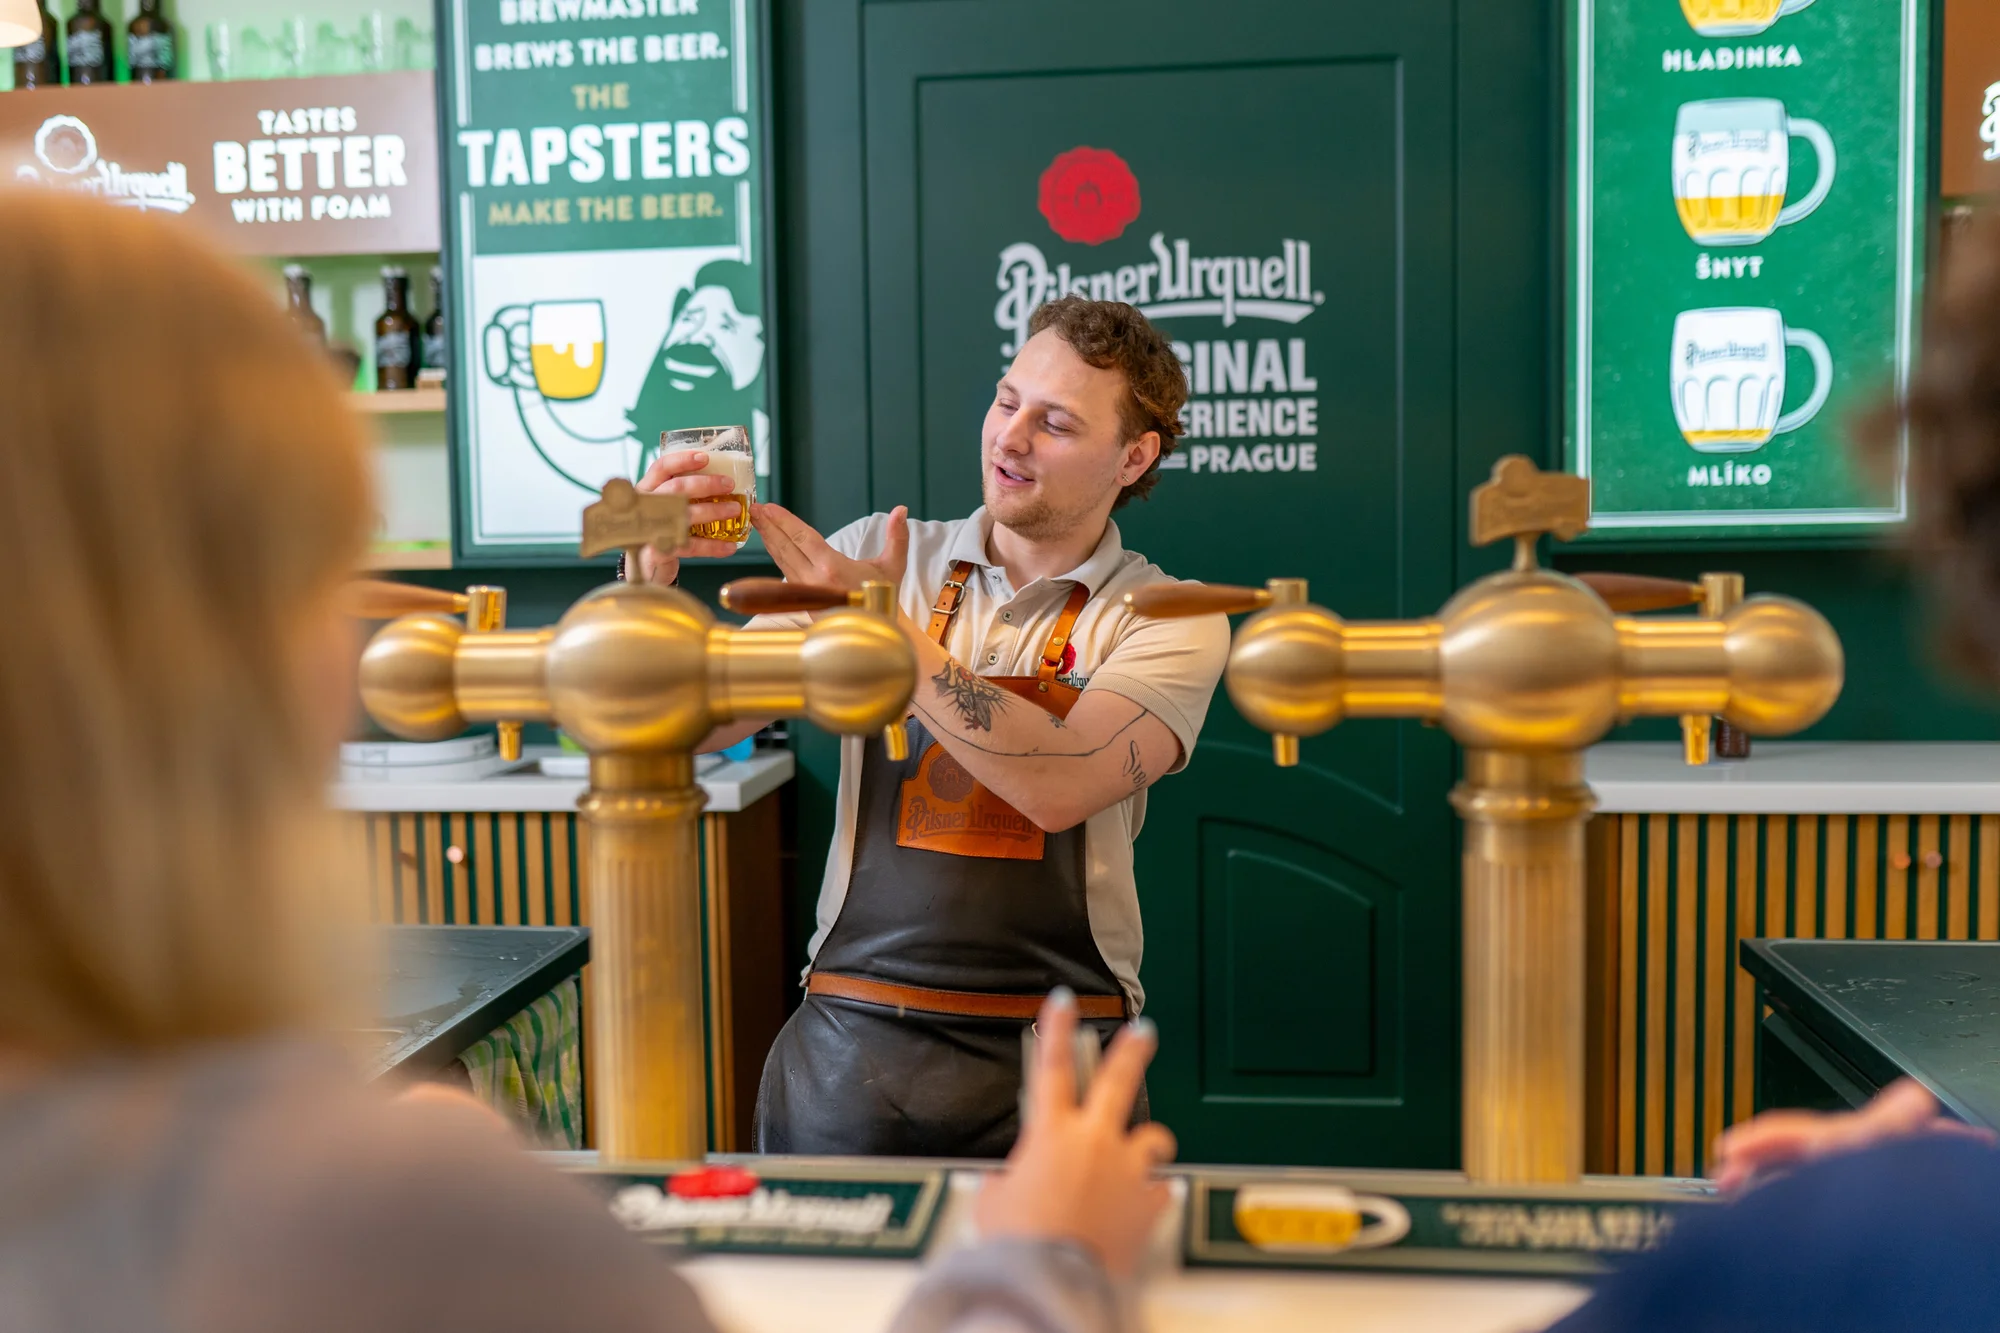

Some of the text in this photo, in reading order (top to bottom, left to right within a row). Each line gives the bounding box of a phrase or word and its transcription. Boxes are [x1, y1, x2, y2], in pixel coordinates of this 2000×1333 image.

[500, 0, 699, 25] BREWMASTER
[475, 32, 729, 71] BREWS THE BEER.
[1662, 45, 1802, 72] HLADINKA
[571, 83, 630, 110] THE
[258, 107, 357, 135] TASTES
[214, 135, 408, 194] BETTER
[457, 117, 750, 187] TAPSTERS
[231, 194, 391, 223] WITH FOAM
[488, 191, 724, 227] MAKE THE BEER.
[1696, 254, 1764, 280] ŠNYT
[1172, 338, 1318, 394] INAL
[1177, 398, 1318, 438] ERIENCE
[1190, 443, 1318, 473] PRAGUE
[1687, 461, 1772, 487] MLÍKO
